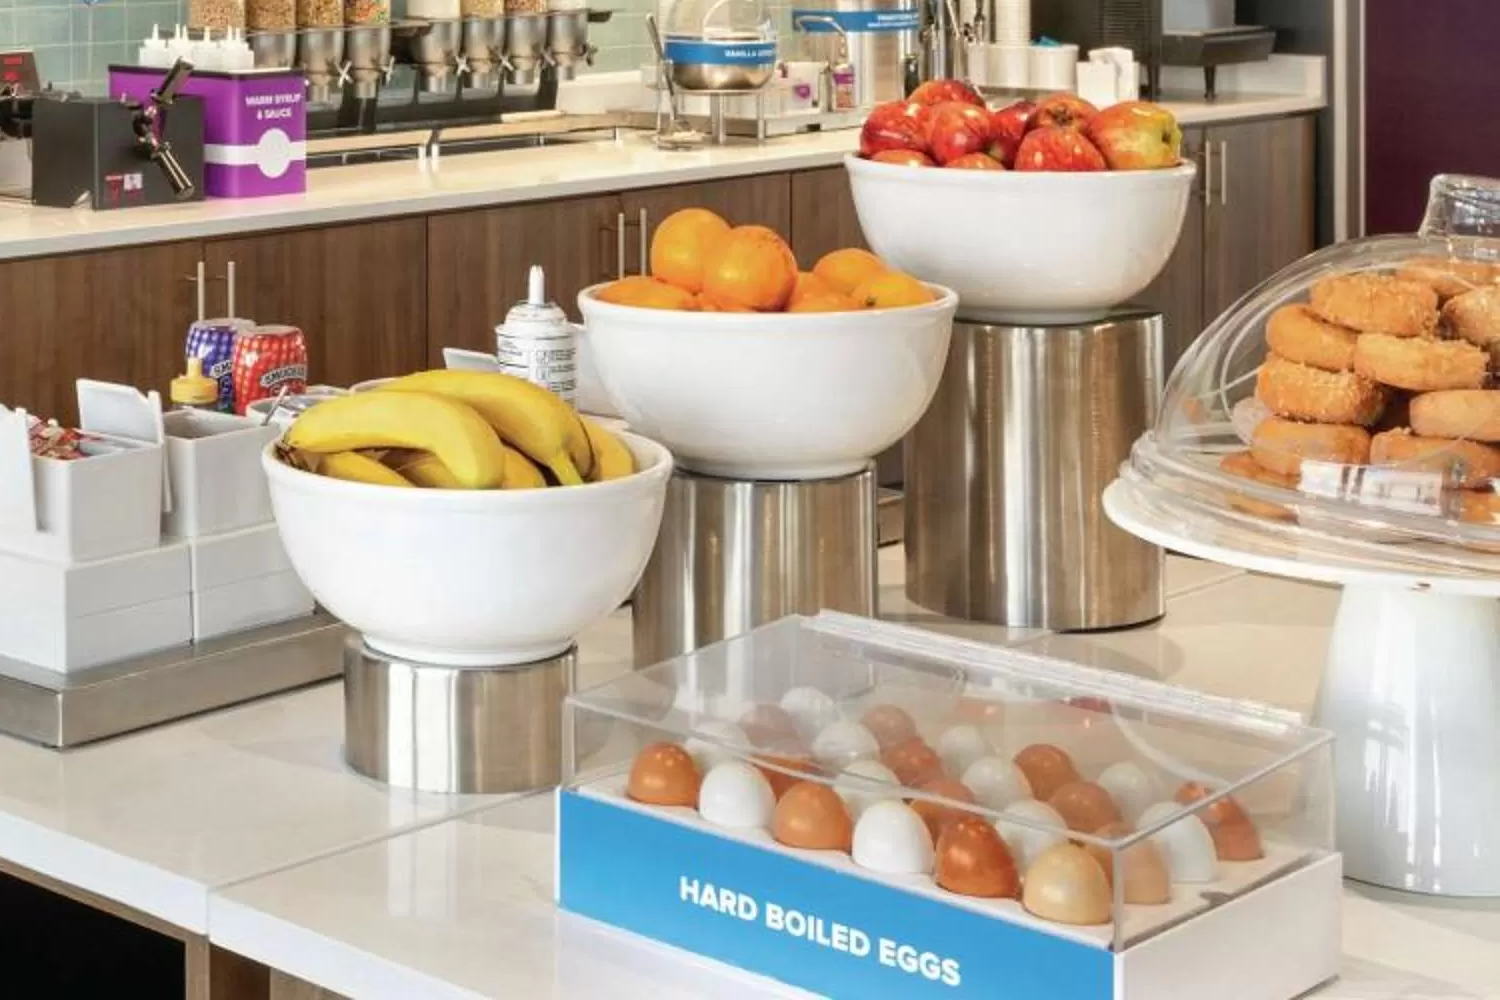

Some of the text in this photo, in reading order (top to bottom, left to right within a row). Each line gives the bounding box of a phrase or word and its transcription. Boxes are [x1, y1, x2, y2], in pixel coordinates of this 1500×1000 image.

[679, 876, 961, 986] HARD BOILED EGGS
